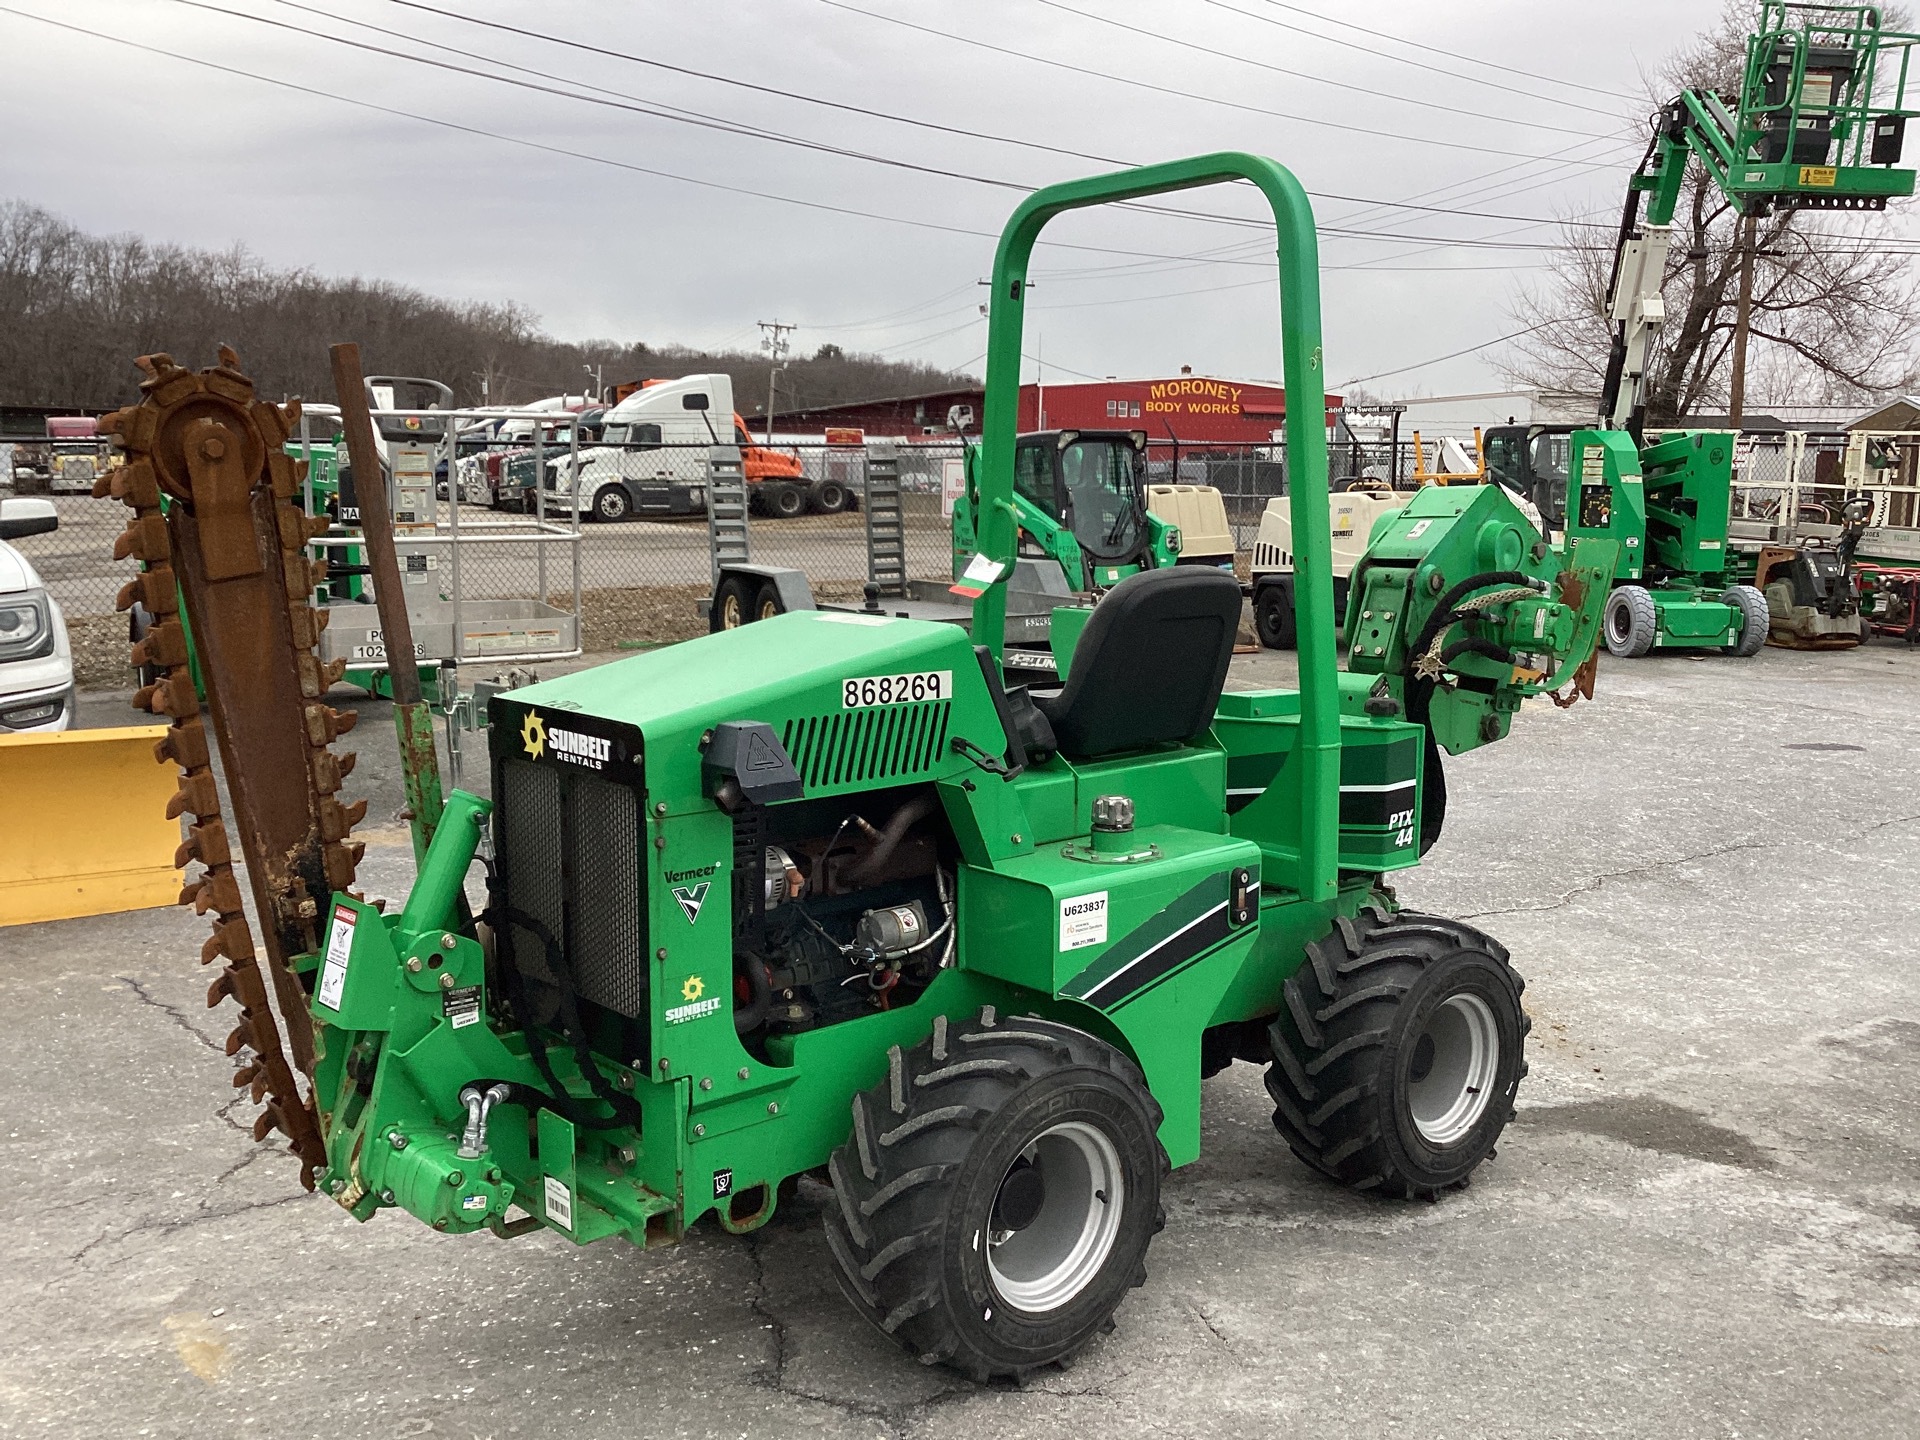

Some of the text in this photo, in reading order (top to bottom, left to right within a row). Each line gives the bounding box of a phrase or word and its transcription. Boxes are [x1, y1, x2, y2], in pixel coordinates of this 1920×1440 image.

[1151, 380, 1242, 402] MORONEY
[1145, 401, 1240, 414] BODY WORKS
[315, 458, 329, 483] JLG
[947, 490, 965, 499] EQUIP
[341, 508, 360, 519] MA
[845, 674, 940, 707] 868269
[548, 727, 611, 762] SUNBELT
[556, 751, 602, 770] RENTALS
[1388, 809, 1415, 830] PTX
[1394, 826, 1414, 848] 44
[664, 865, 718, 883] Vermeer
[1064, 899, 1106, 917] U623837
[665, 997, 721, 1021] SUNBELT
[673, 1010, 713, 1025] RENTALS
